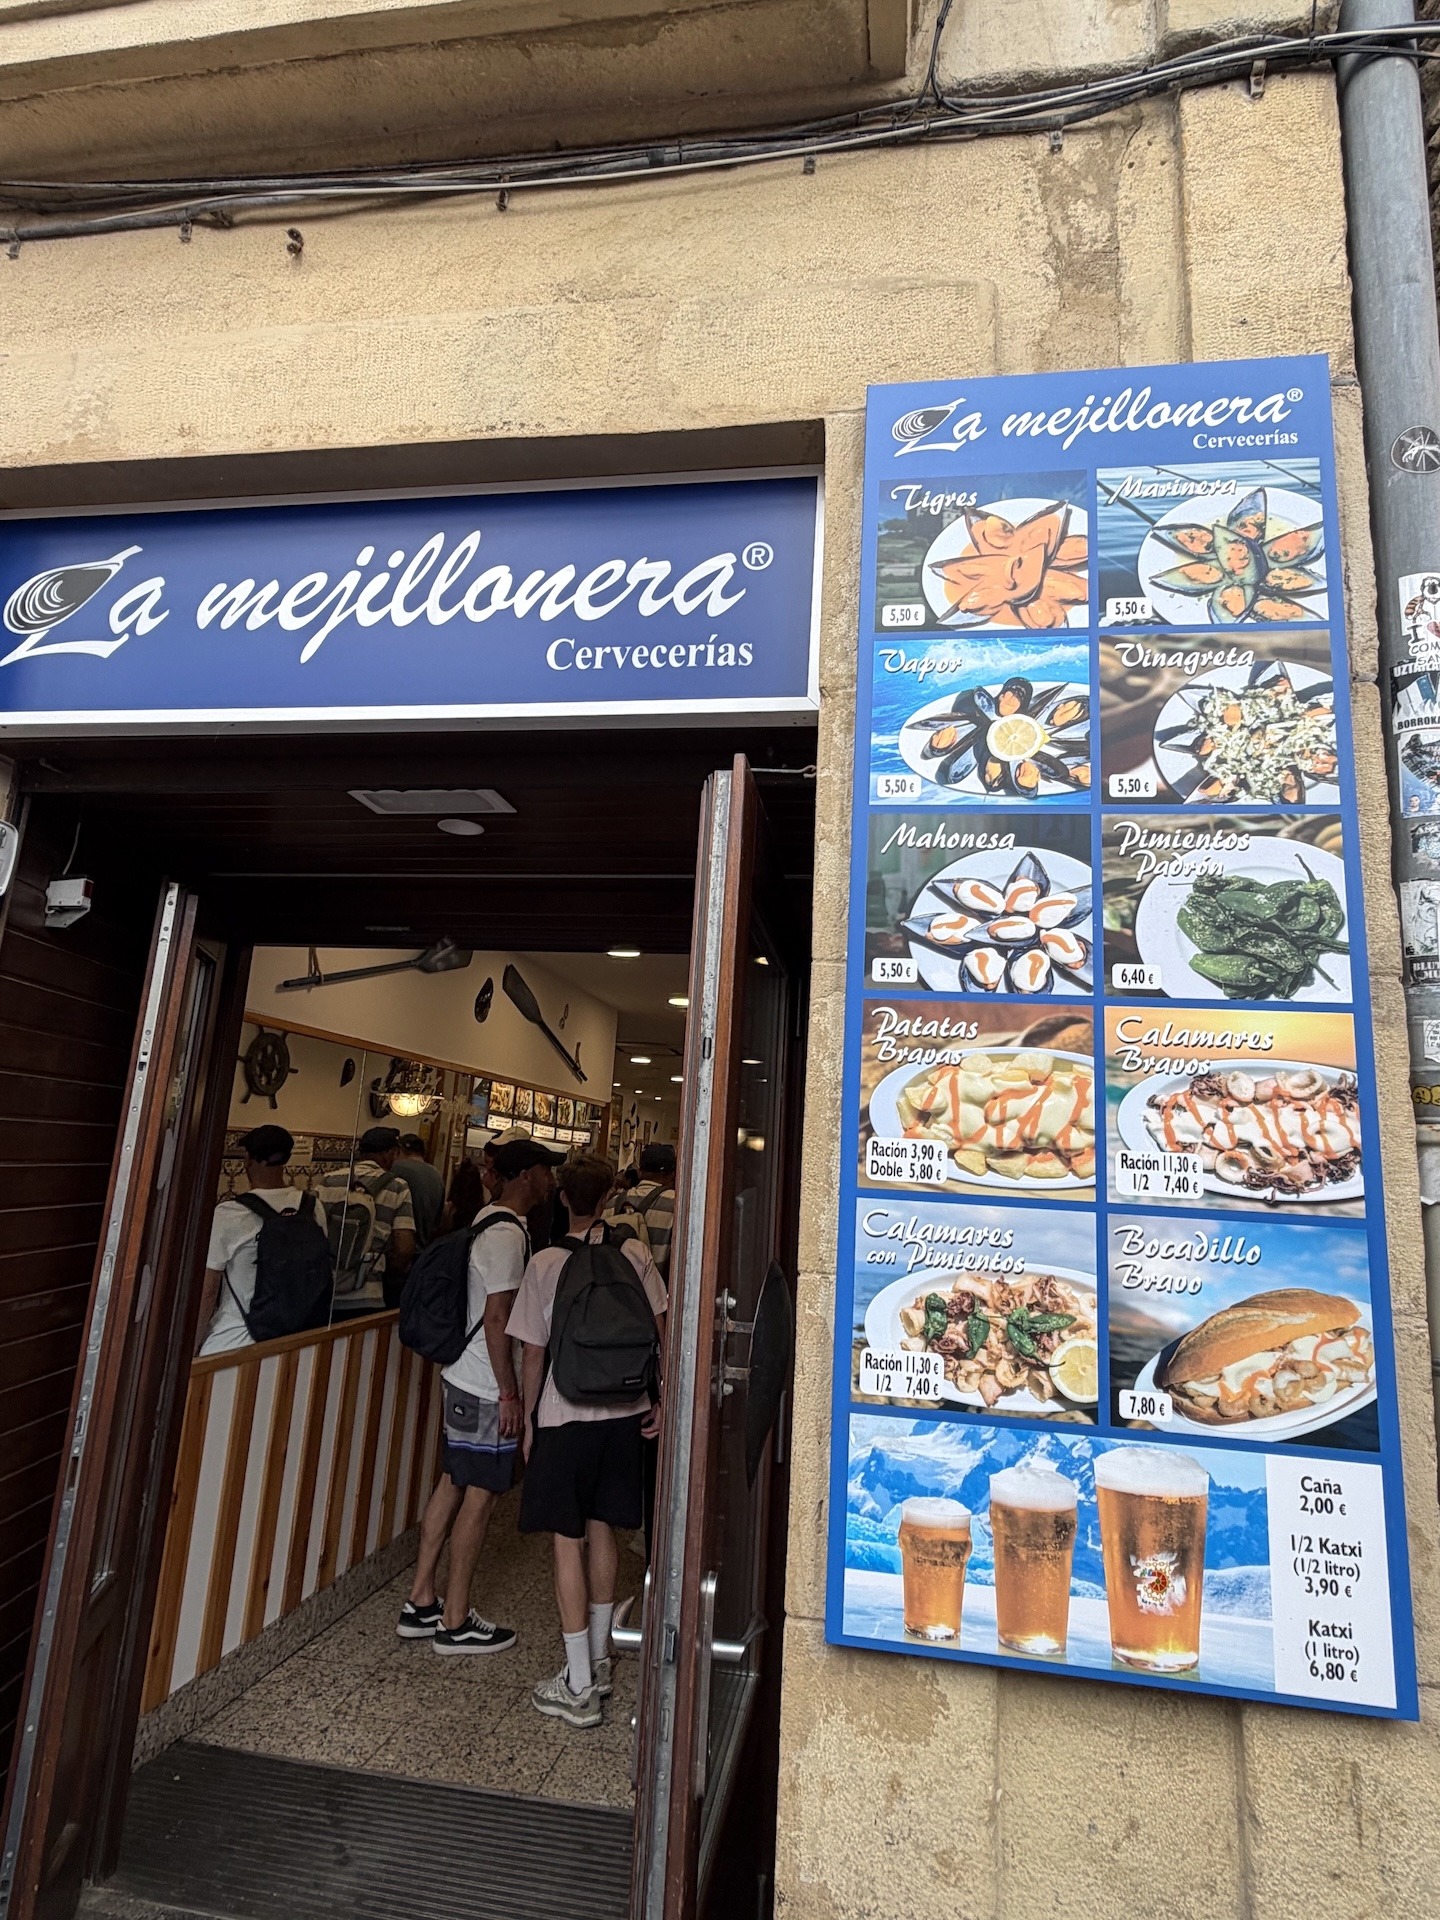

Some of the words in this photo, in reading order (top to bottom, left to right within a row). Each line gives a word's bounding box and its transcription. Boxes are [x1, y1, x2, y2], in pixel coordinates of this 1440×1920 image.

[891, 397, 986, 458] La
[1192, 430, 1299, 450] Cervecerías
[891, 483, 978, 512] Tigres
[1108, 474, 1237, 504] Marinera
[889, 608, 912, 623] 5,50
[913, 610, 919, 621] €
[1115, 602, 1136, 617] 5,50
[1138, 604, 1147, 615] €
[545, 633, 754, 674] Cervecerías
[878, 648, 963, 674] Vapor
[1115, 643, 1255, 675] Vinagreta
[884, 779, 907, 795] 5,50
[908, 781, 916, 792] €
[1117, 778, 1141, 795] 5,50
[1143, 781, 1150, 792] €
[881, 823, 1016, 854] Mahonesa
[1113, 822, 1251, 855] Pimientos
[1135, 850, 1225, 882] Padrón
[879, 962, 903, 979] 5,50
[905, 966, 911, 977] €
[1120, 969, 1146, 987] 6,40
[1147, 973, 1154, 984] €
[871, 1006, 979, 1040] Patatas
[1115, 1016, 1274, 1051] Calamares
[876, 1037, 962, 1067] Bravas
[1118, 1047, 1211, 1077] Bravos
[871, 1141, 908, 1160] Ración
[911, 1143, 935, 1162] 3,90
[937, 1149, 943, 1161] €
[1120, 1152, 1161, 1171] Ración
[1162, 1156, 1189, 1174] 11,30
[1192, 1161, 1198, 1173] €
[870, 1161, 904, 1177] Doble
[908, 1163, 933, 1181] 5,80
[935, 1169, 942, 1181] €
[1132, 1173, 1150, 1191] 1/2
[1163, 1175, 1188, 1193] 7,40
[1191, 1180, 1198, 1193] €
[861, 1208, 1014, 1249] Calamares
[866, 1248, 896, 1266] con
[903, 1240, 1025, 1275] Pimientos
[1114, 1225, 1262, 1265] Bocadillo
[1114, 1262, 1203, 1295] Bravo
[864, 1351, 903, 1372] Ración
[905, 1354, 931, 1377] 11,30
[933, 1360, 940, 1374] €
[875, 1373, 892, 1393] 1/2
[906, 1376, 930, 1396] 7,40
[932, 1382, 939, 1396] €
[1129, 1395, 1156, 1417] 7,80
[1158, 1402, 1165, 1417] €
[1300, 1475, 1343, 1496] Caña
[1299, 1495, 1334, 1516] 2,00
[1339, 1503, 1347, 1516] €
[1290, 1534, 1314, 1554] 1/2
[1318, 1537, 1363, 1558] Katxi
[1293, 1557, 1321, 1576] (1/2
[1325, 1559, 1361, 1582] litro)
[1304, 1577, 1340, 1598] 3,90
[1344, 1585, 1352, 1598] €
[1308, 1619, 1353, 1640] Katxi
[1304, 1641, 1318, 1660] (1
[1323, 1643, 1360, 1666] litro)
[1309, 1660, 1345, 1682] 6,80
[1350, 1669, 1358, 1682] €
